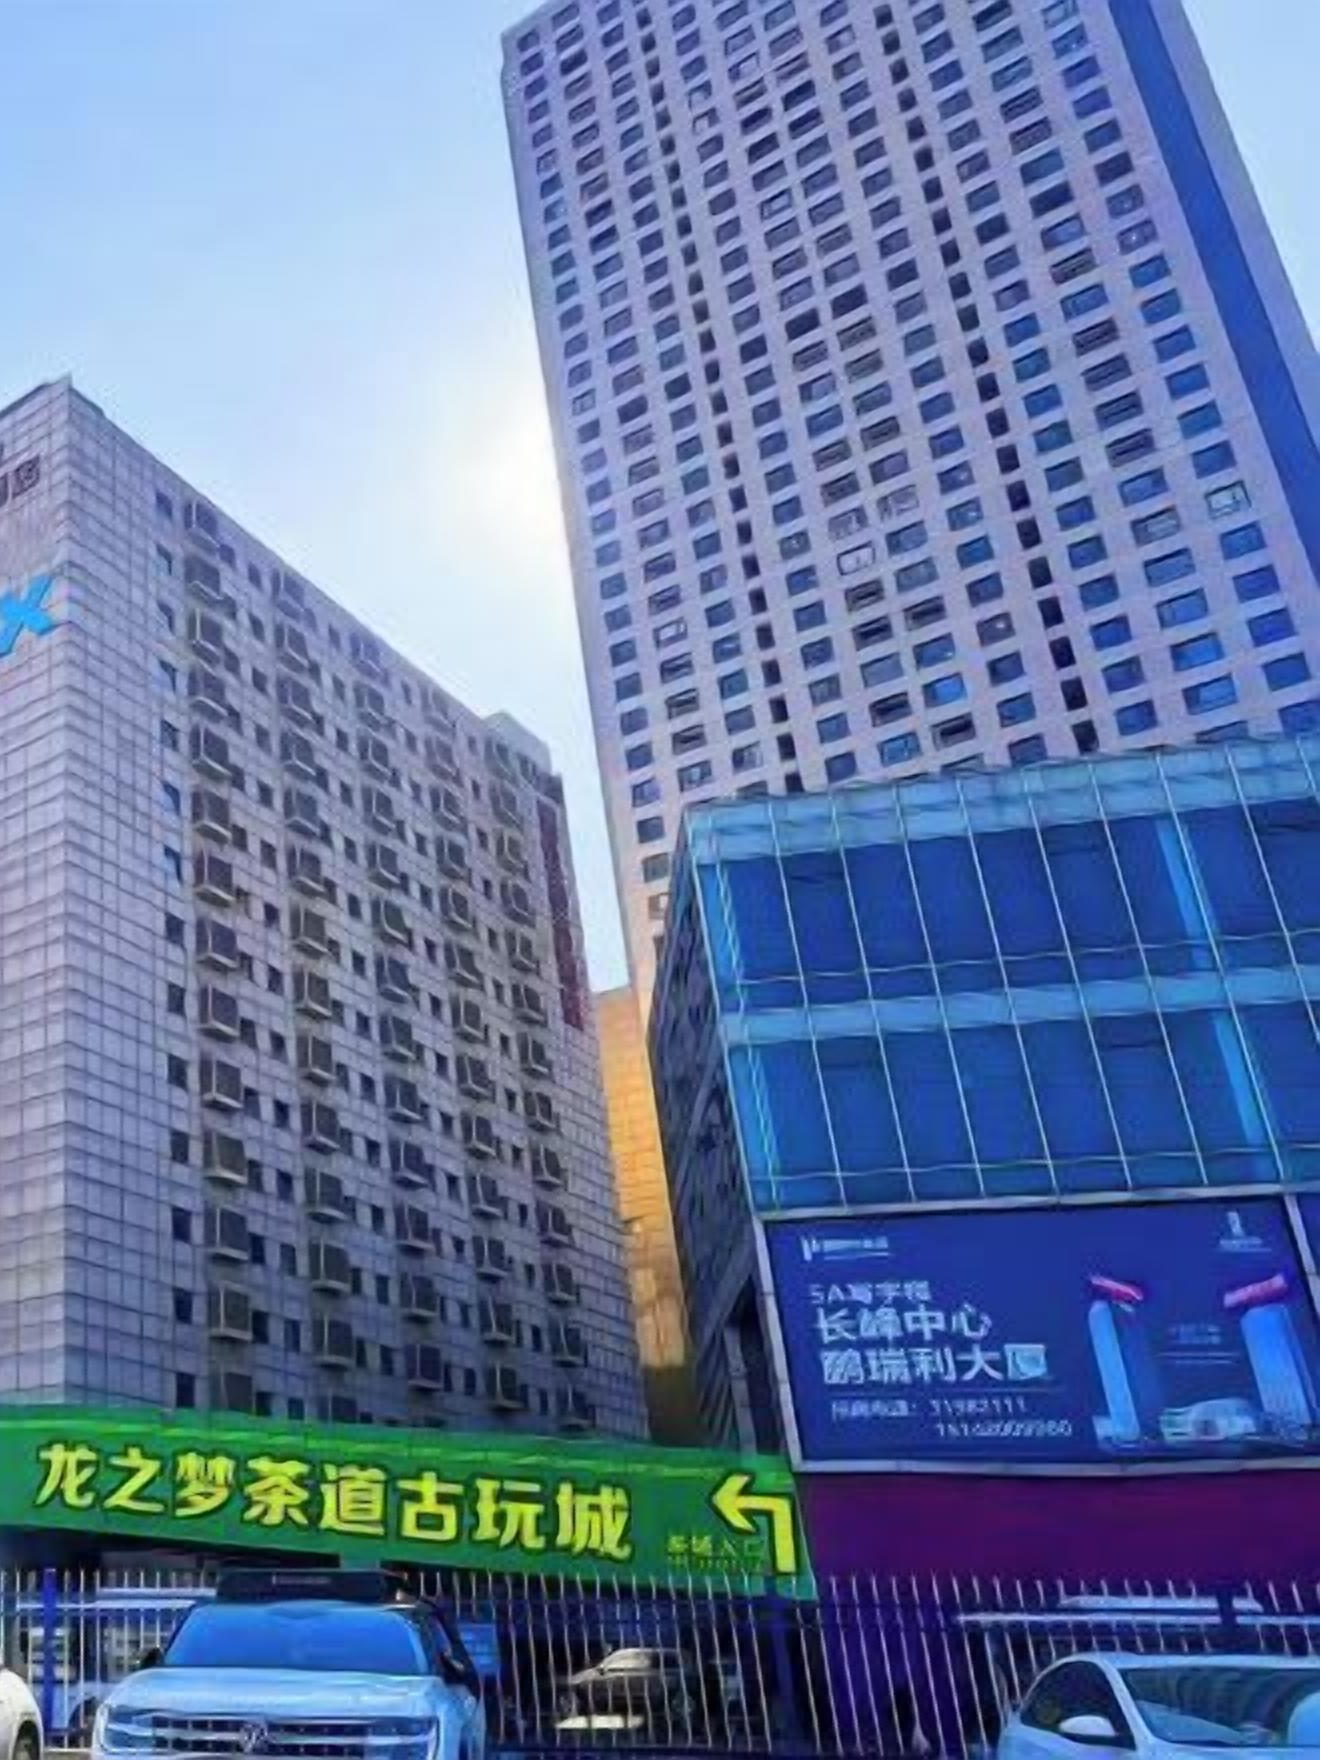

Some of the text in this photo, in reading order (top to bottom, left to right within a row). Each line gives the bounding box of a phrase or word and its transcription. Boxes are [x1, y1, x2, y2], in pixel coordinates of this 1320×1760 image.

[816, 1302, 993, 1345] 长峰中心
[36, 1441, 634, 1561] 龙之梦茶道古玩城
